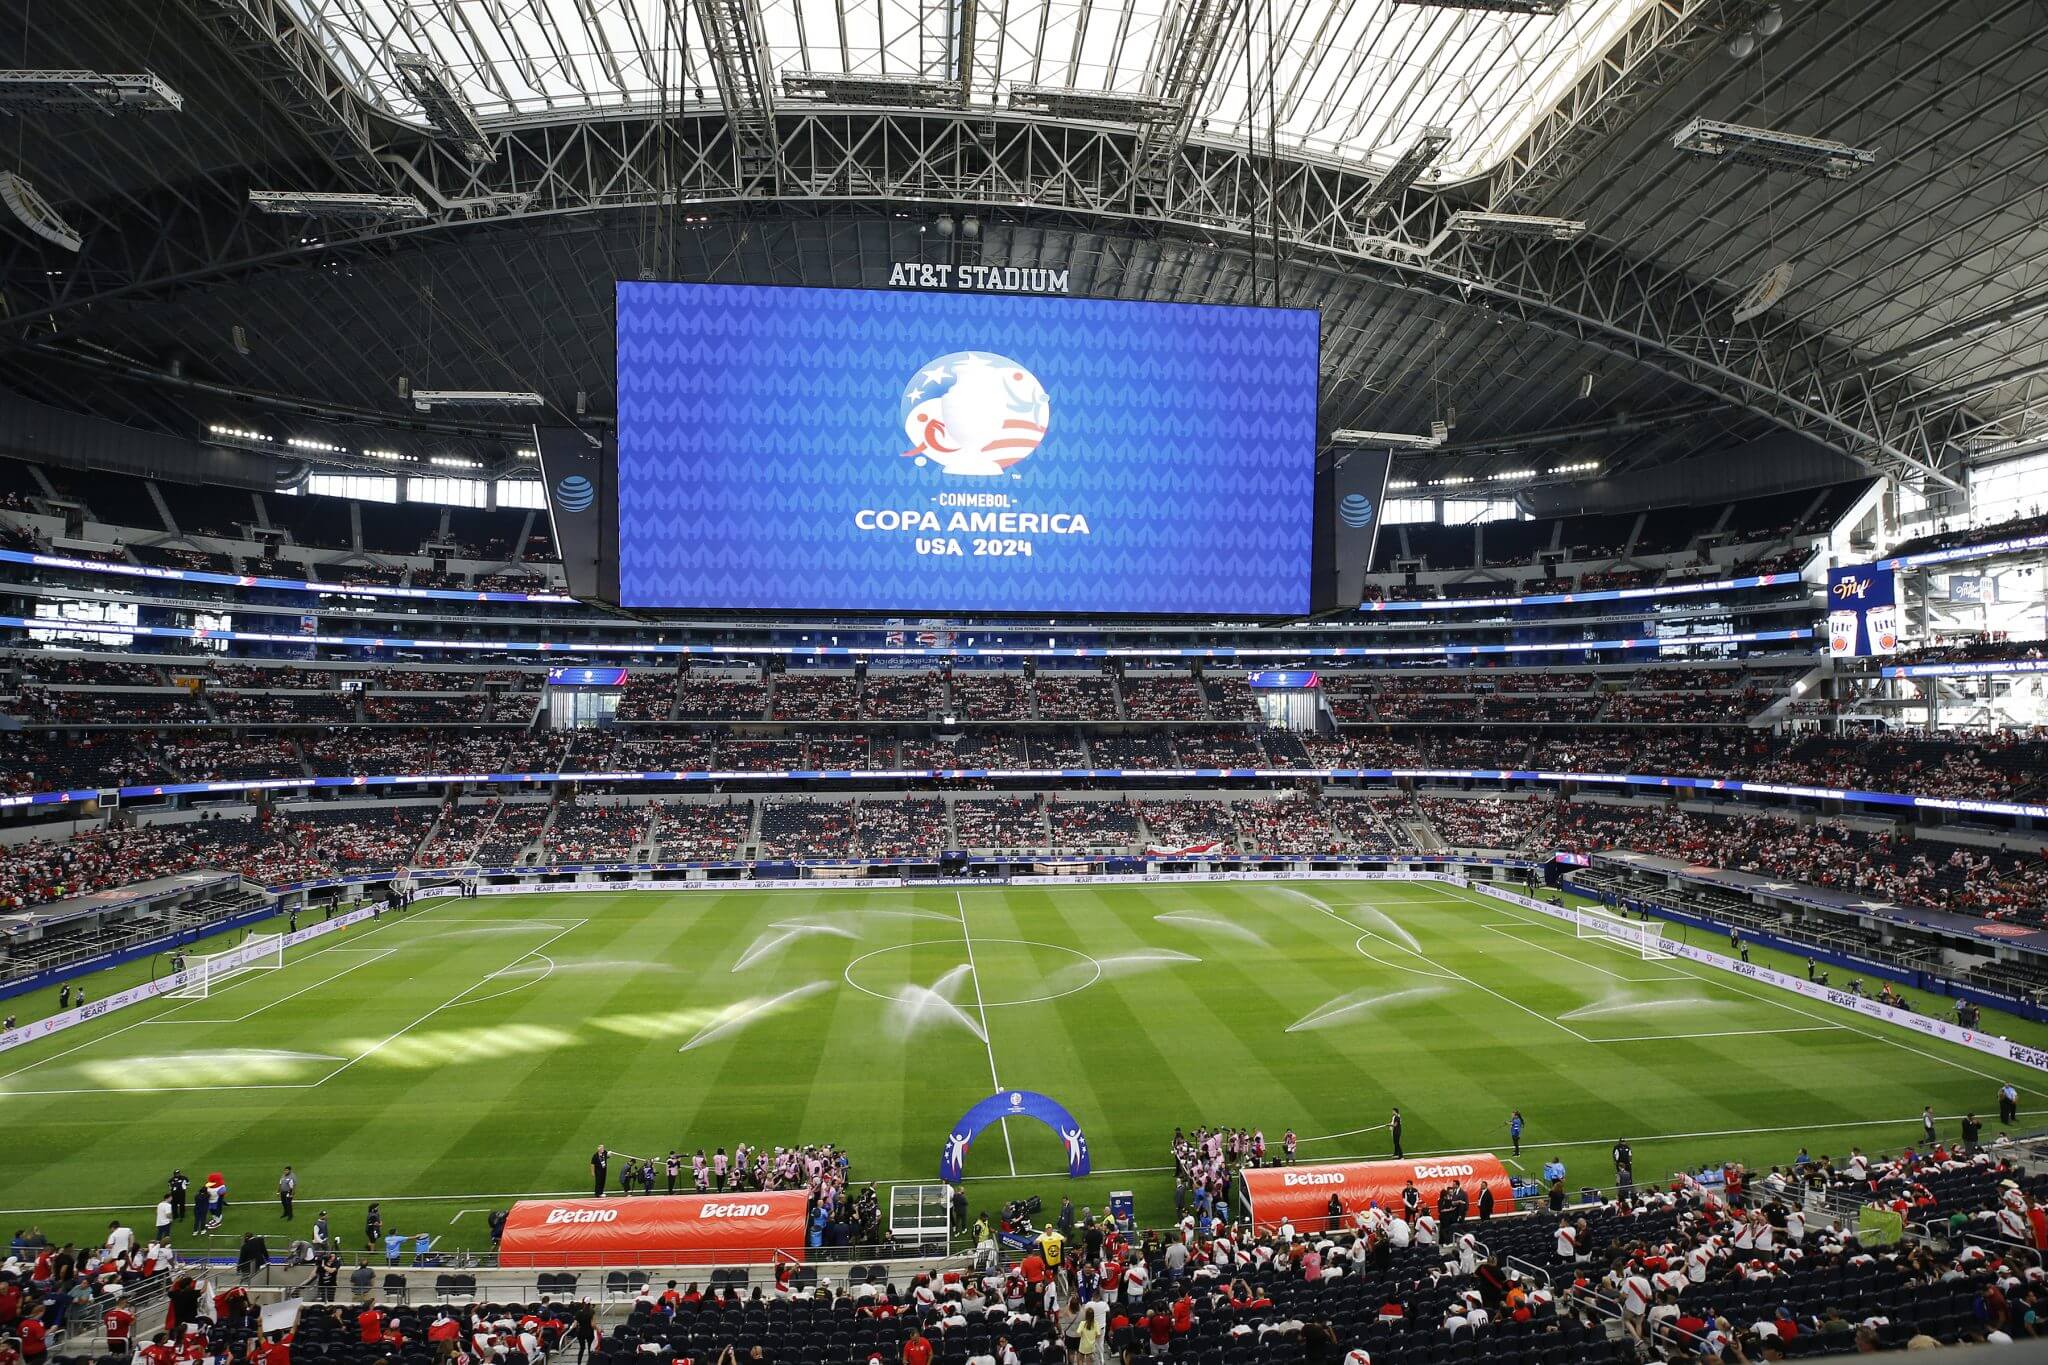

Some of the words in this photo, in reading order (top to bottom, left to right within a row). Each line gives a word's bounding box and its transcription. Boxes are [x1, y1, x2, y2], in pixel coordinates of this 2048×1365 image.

[889, 262, 951, 288] AT&T
[958, 265, 1069, 293] STADIUM
[854, 510, 941, 531] COPA
[947, 511, 1090, 534] AMERICA
[915, 538, 964, 556] USA
[973, 538, 1032, 556] 2024
[1732, 965, 1756, 977] HEART
[1827, 994, 1857, 1010] HEART
[80, 1004, 108, 1020] HEART
[2009, 1043, 2032, 1056] WEAR
[1283, 1172, 1345, 1187] Betano
[1413, 1164, 1474, 1180] Betano
[546, 1208, 618, 1224] Betano
[700, 1203, 769, 1219] Betano
[22, 1326, 29, 1337] 9
[107, 1320, 117, 1330] 10
